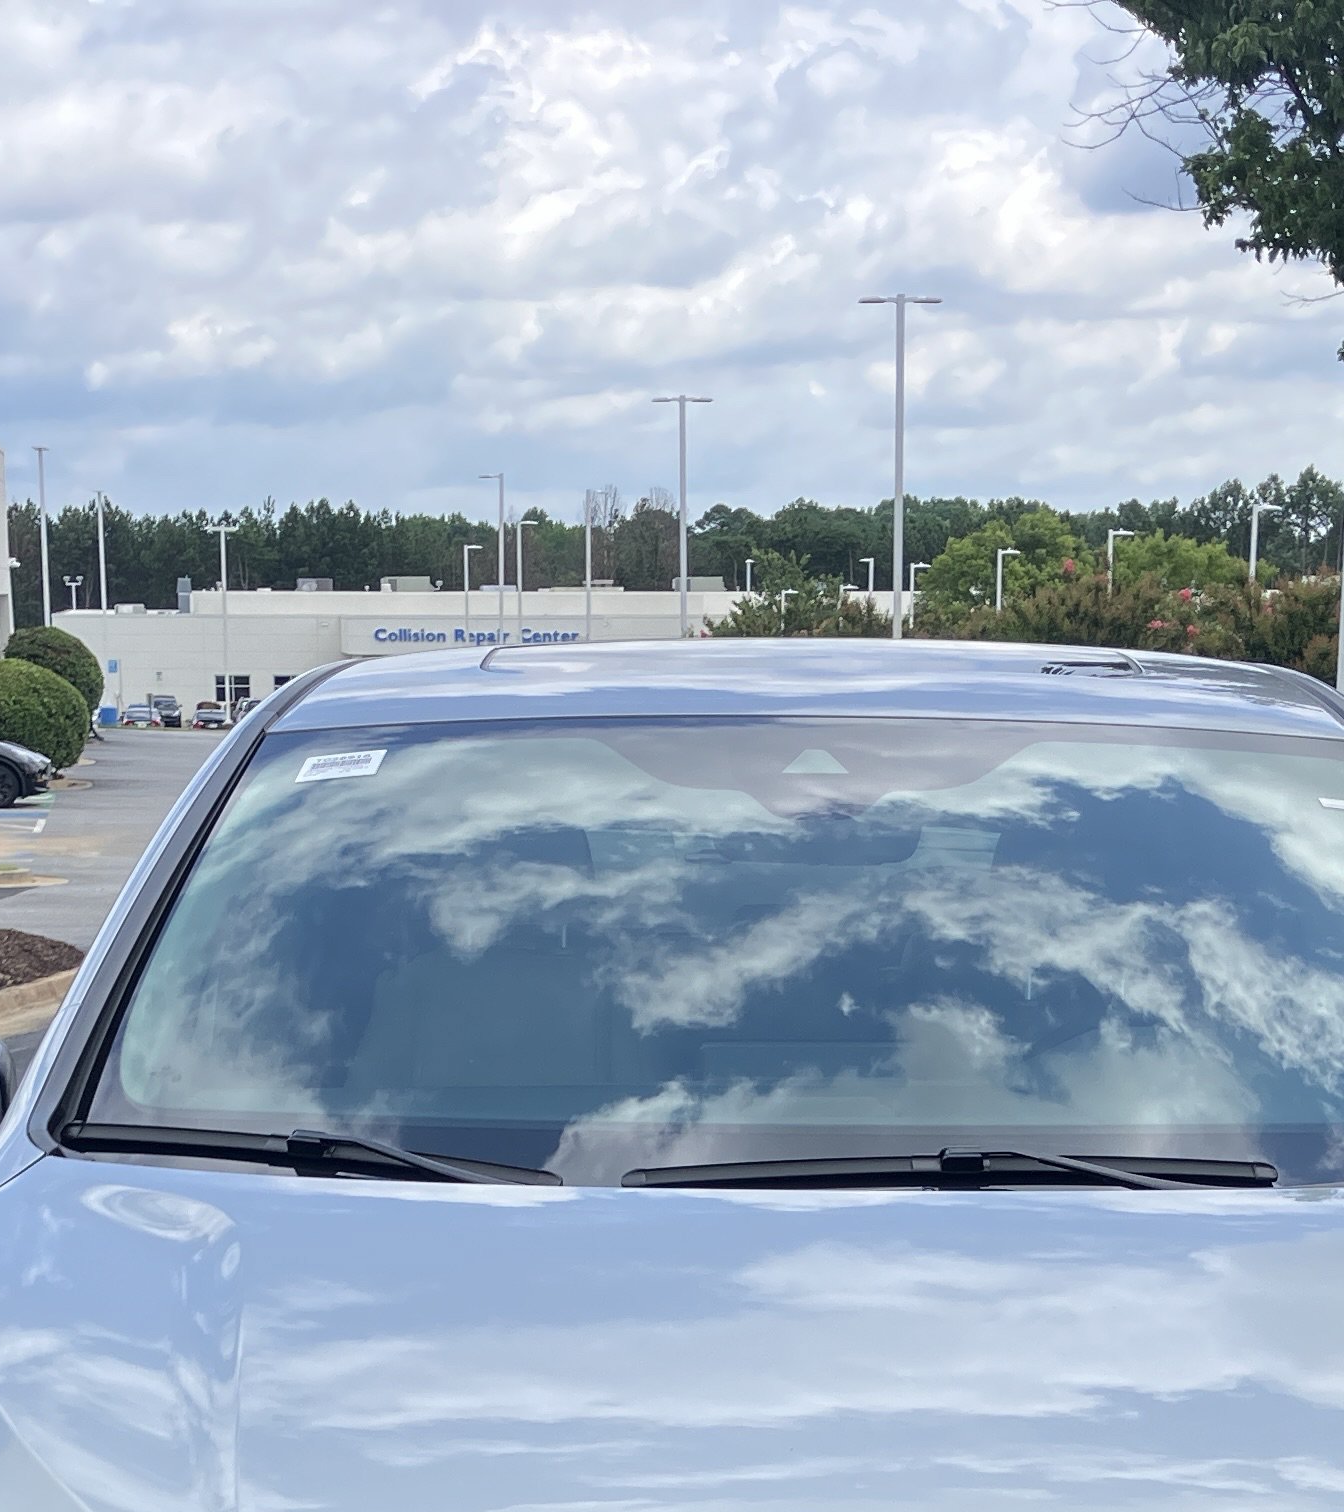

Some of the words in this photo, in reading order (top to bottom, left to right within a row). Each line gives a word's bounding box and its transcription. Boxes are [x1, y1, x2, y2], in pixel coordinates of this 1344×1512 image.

[374, 628, 446, 642] Collision
[454, 628, 509, 646] Repair
[521, 628, 578, 643] Center
